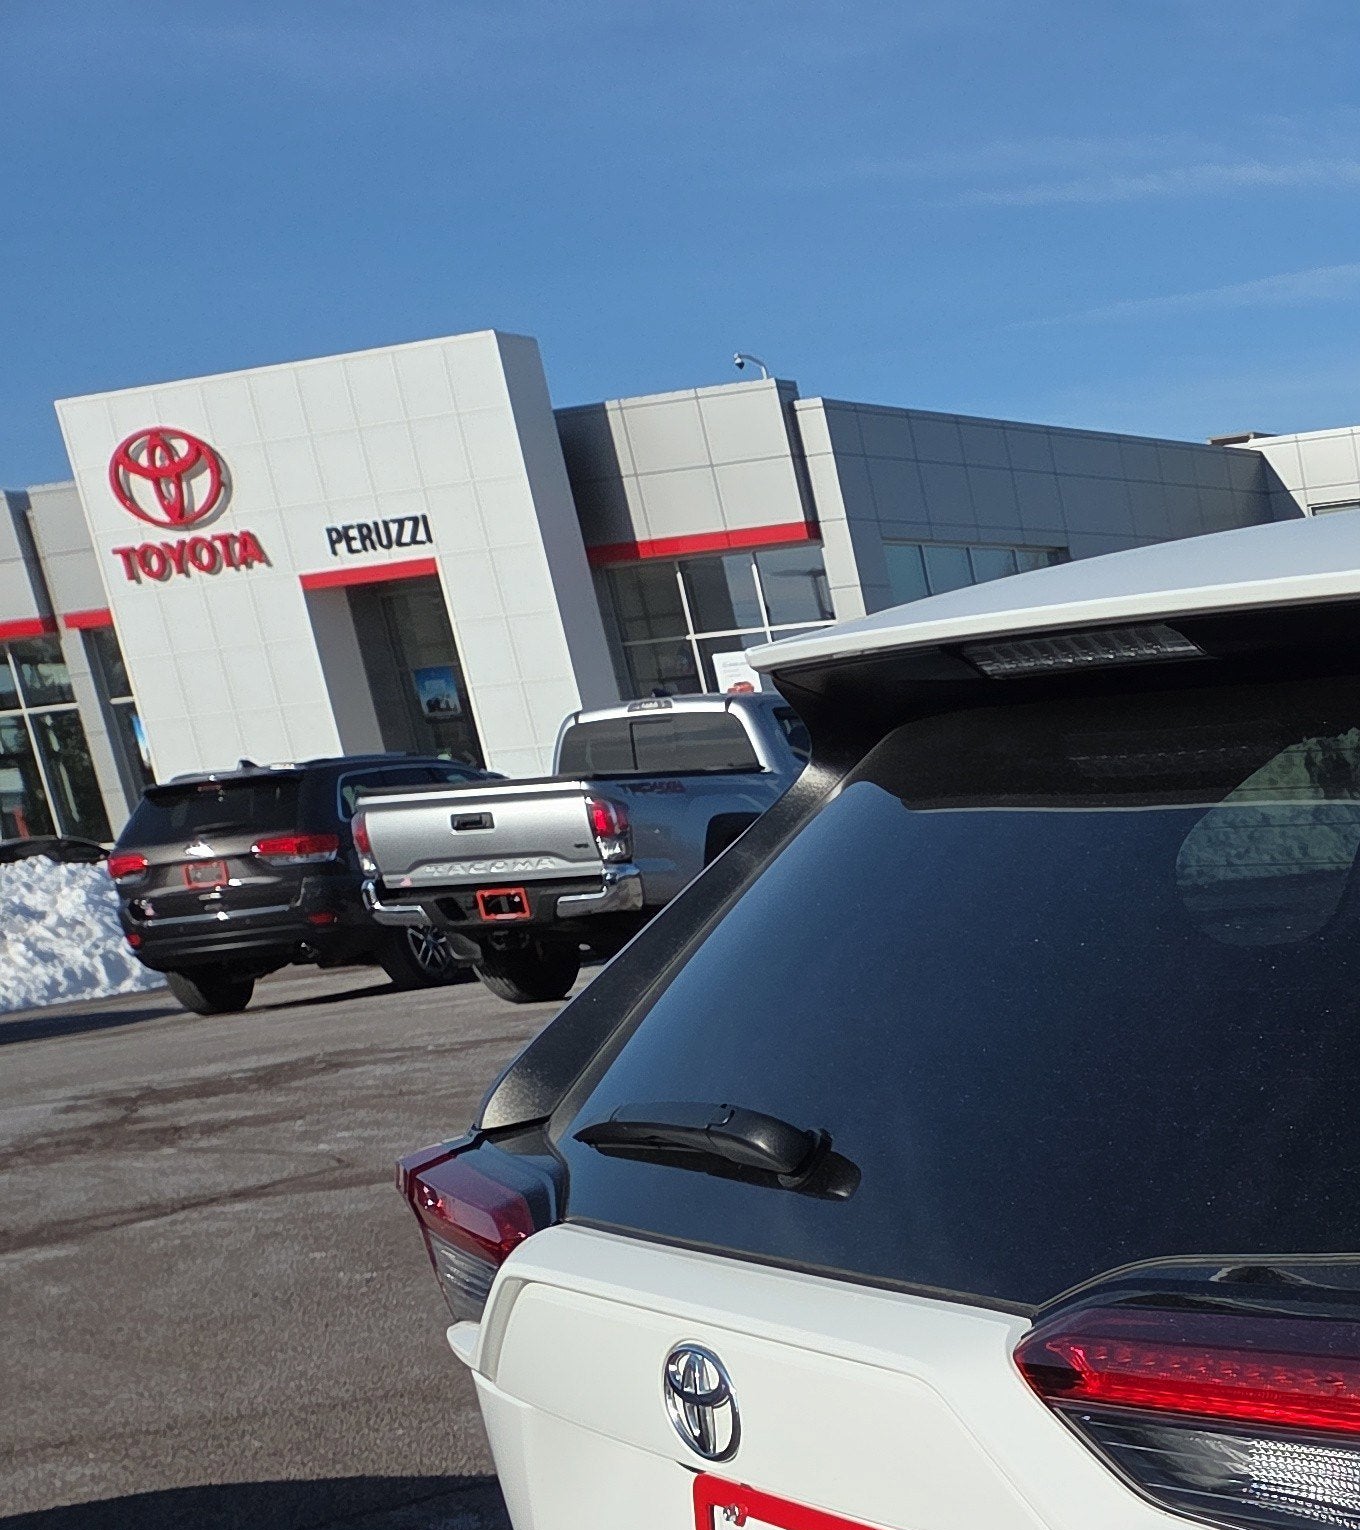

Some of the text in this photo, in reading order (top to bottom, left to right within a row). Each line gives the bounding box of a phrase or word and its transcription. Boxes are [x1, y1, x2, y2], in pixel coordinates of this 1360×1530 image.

[112, 529, 269, 583] TOYOTA
[325, 514, 434, 557] PERUZZI
[424, 855, 557, 877] TACOMA
